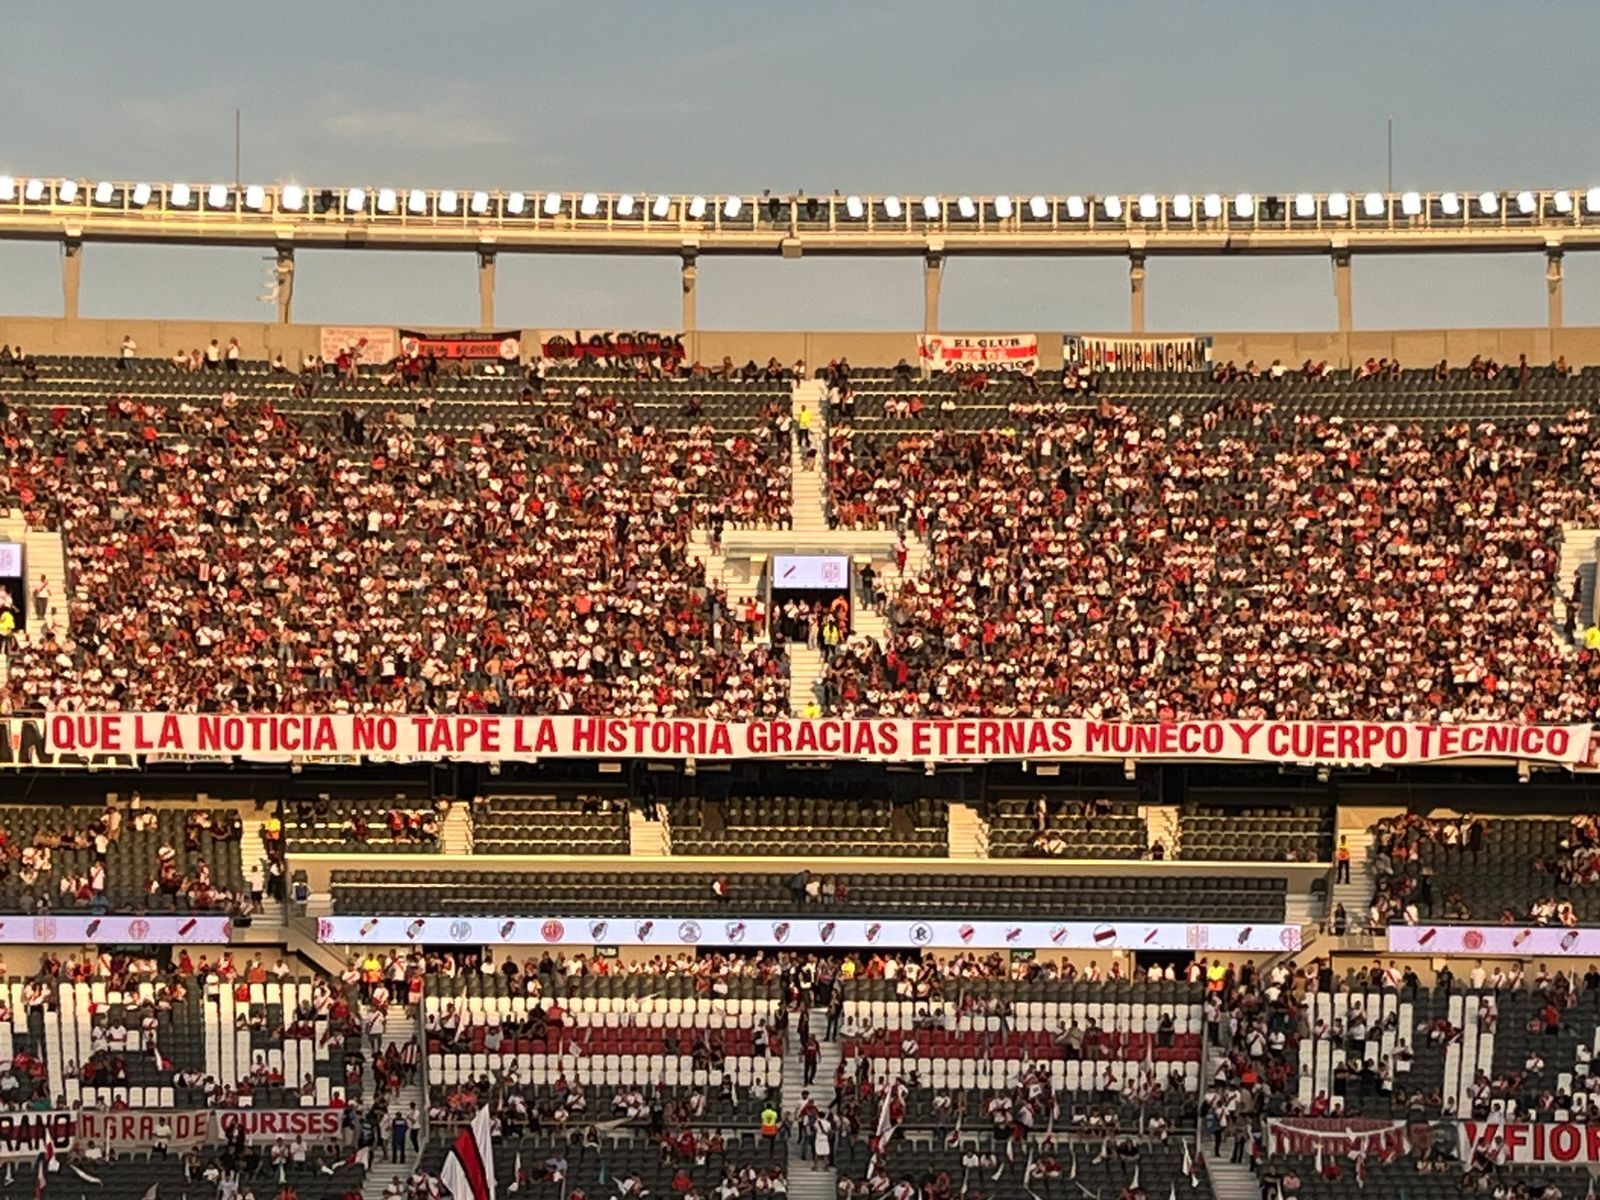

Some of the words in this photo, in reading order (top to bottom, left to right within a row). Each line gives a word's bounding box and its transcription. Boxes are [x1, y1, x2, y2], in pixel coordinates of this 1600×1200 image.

[954, 339, 974, 348] EL
[978, 338, 1021, 348] CLUB
[52, 716, 120, 751] QUE
[135, 715, 183, 749] LA
[199, 717, 336, 751] NOTICIA
[353, 716, 397, 751] NO
[411, 718, 500, 752] TAPE
[514, 719, 557, 753] LA
[572, 718, 732, 755] HISTORIA
[746, 721, 897, 755] GRACIAS
[912, 721, 1071, 755] ETERNAS
[1230, 723, 1264, 754] Y
[1267, 724, 1407, 759] CUERPO
[1415, 725, 1570, 758] TECNICO
